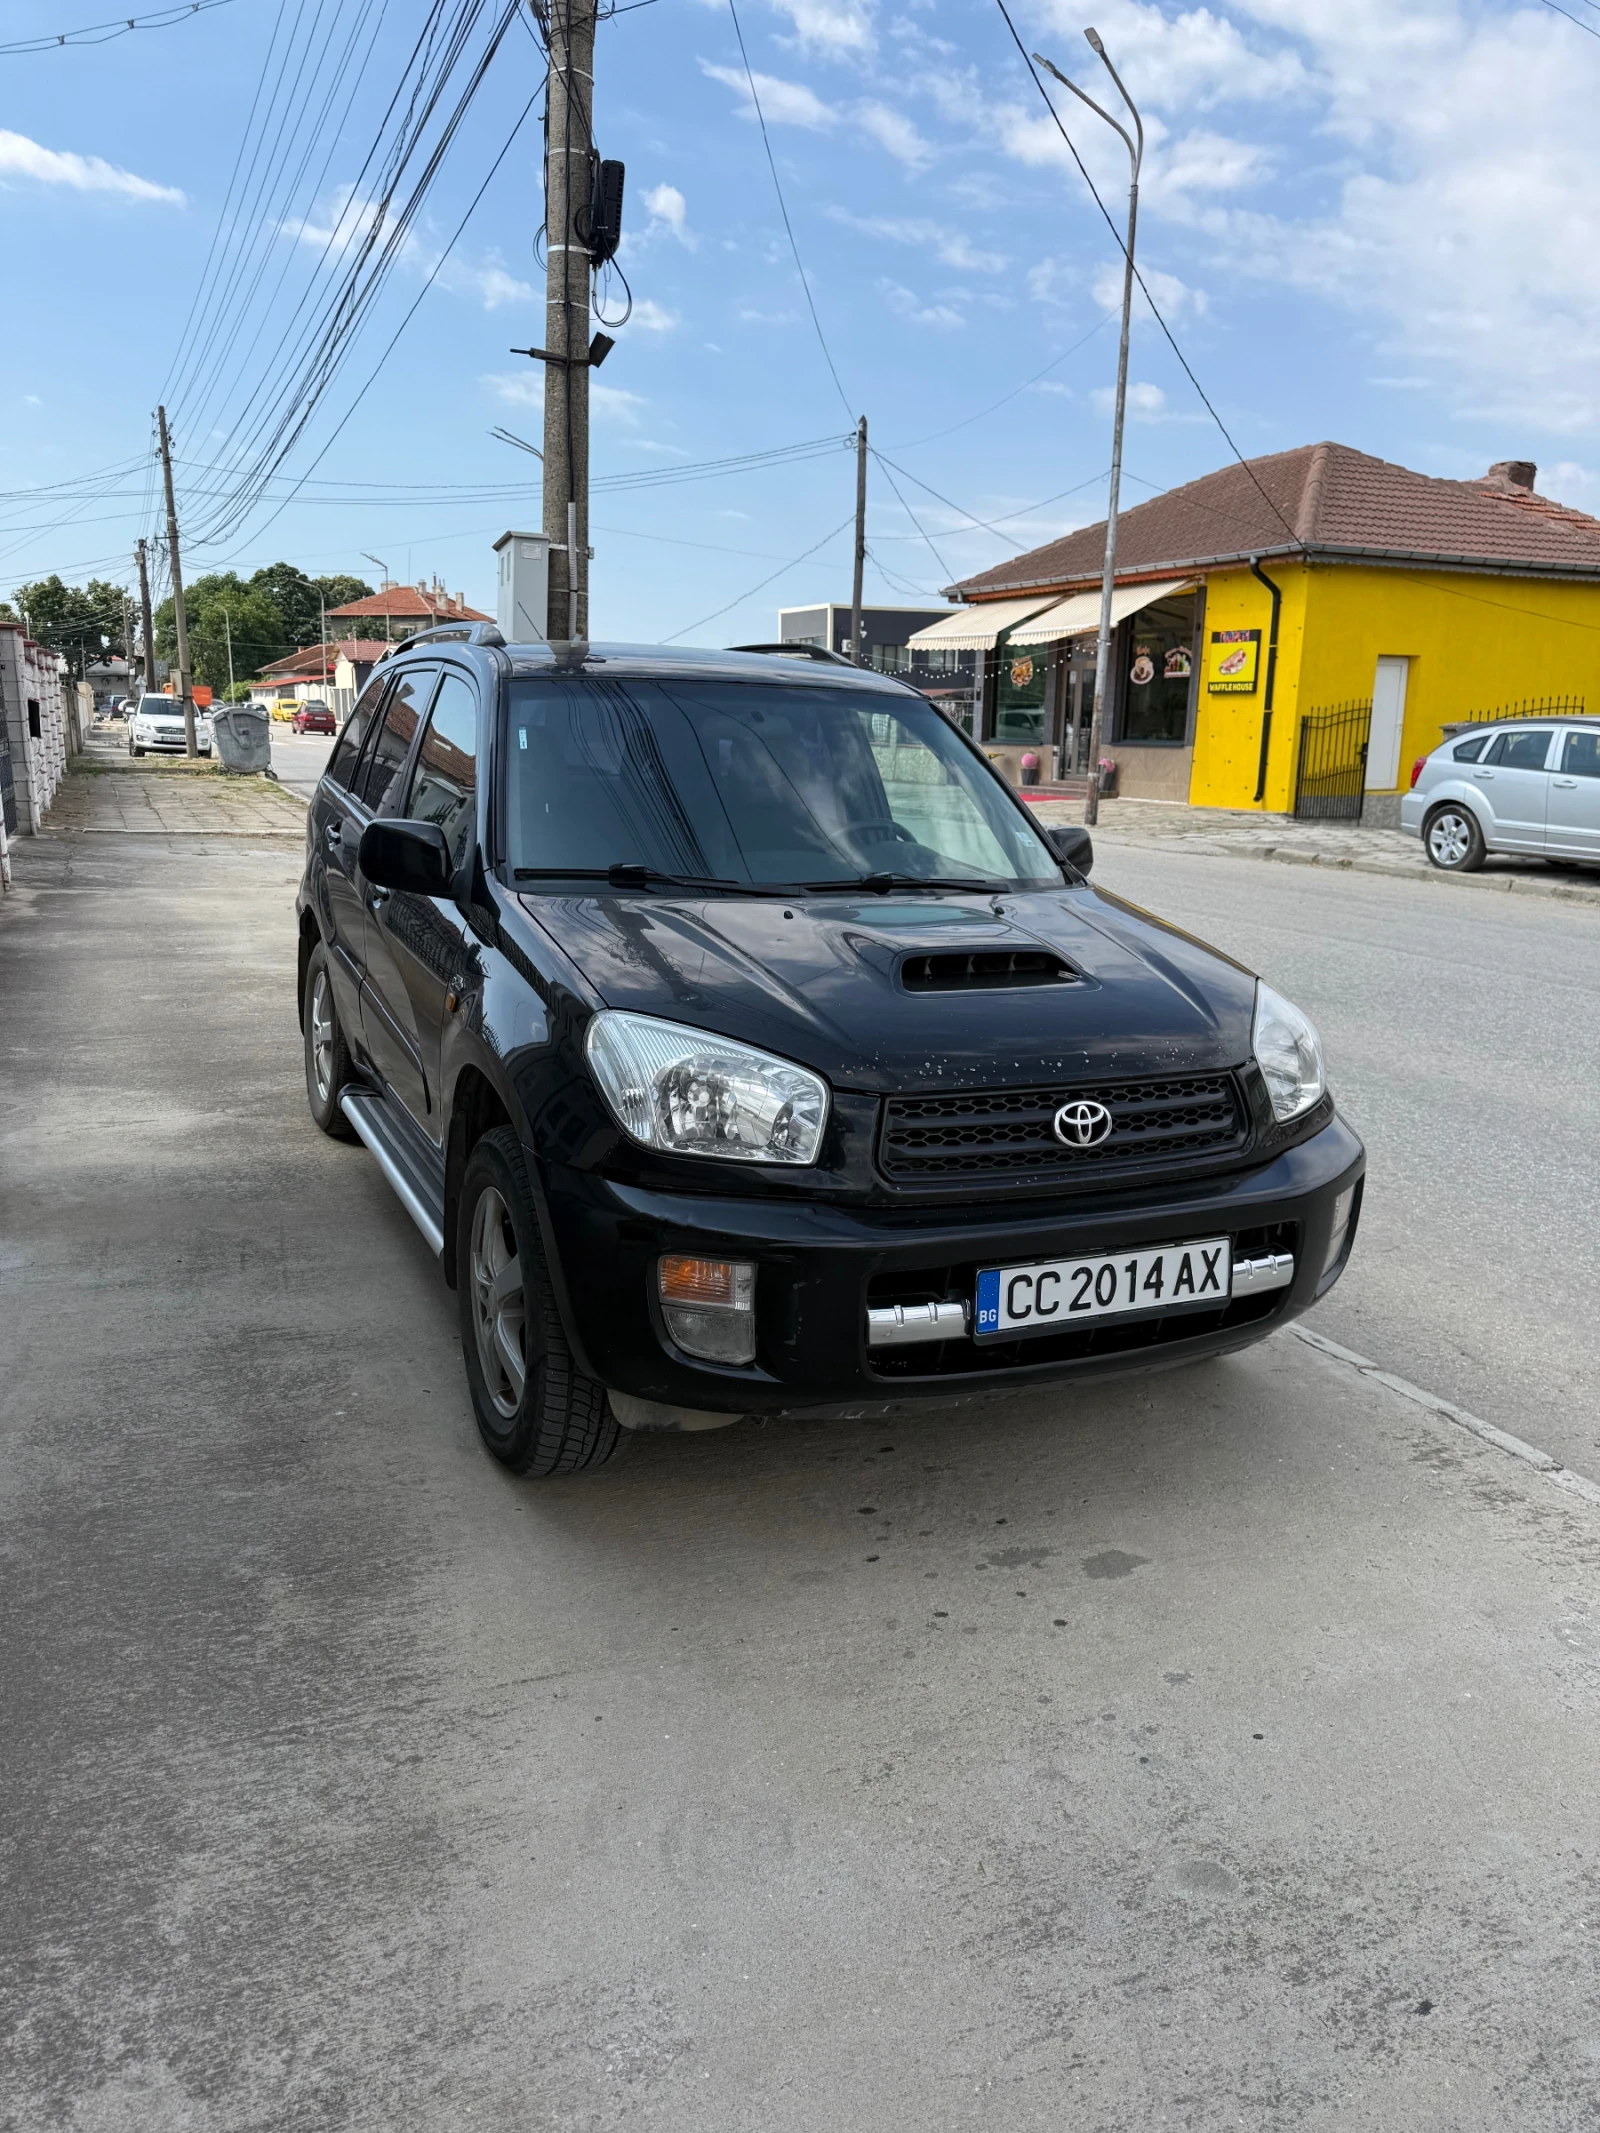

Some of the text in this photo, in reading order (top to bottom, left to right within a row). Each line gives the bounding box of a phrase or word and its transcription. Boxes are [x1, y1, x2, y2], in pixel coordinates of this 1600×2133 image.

[1209, 683, 1253, 692] WAFFLE HOUSE
[1007, 1247, 1222, 1320] CC 2014 AX
[979, 1309, 997, 1324] BG
